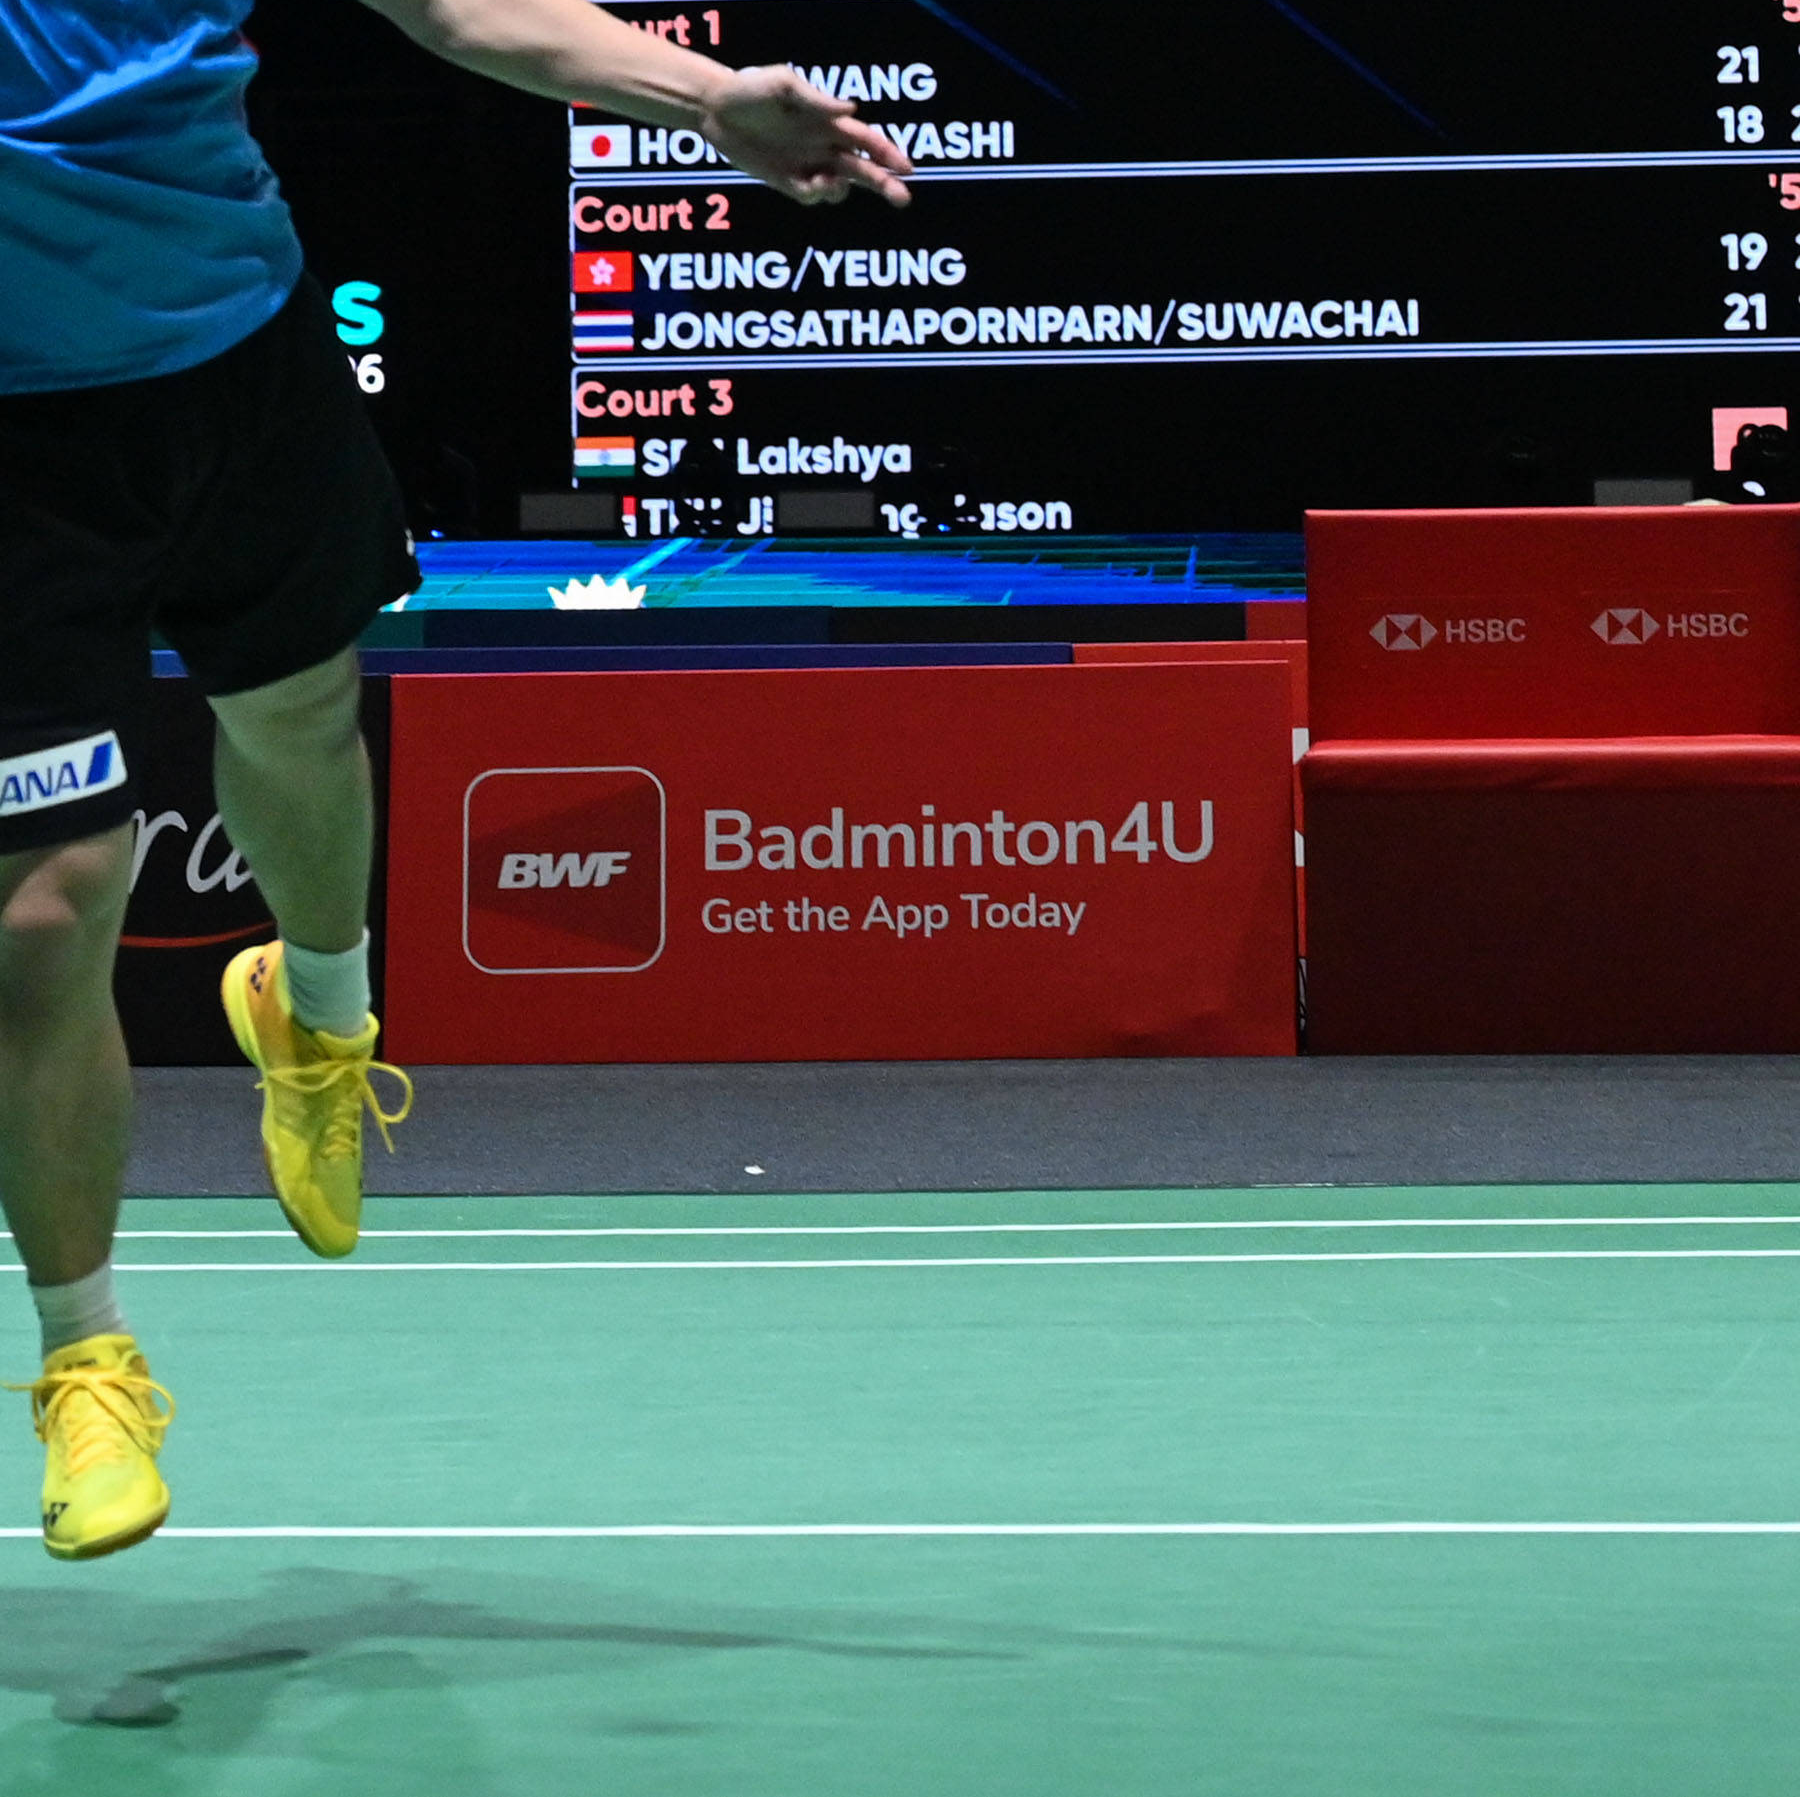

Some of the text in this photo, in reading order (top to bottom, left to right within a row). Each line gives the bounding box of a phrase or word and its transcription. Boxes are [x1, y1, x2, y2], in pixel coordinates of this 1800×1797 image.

[703, 9, 719, 45] 1
[788, 61, 937, 102] WANG
[1717, 45, 1760, 84] 21
[1717, 105, 1764, 143] 18
[574, 194, 731, 232] Court 2
[639, 246, 967, 292] YEUNG/YEUNG
[1720, 232, 1768, 270] 19
[642, 299, 1420, 351] JONGSATHAPORNPARN/SUWACHAI
[1724, 293, 1767, 331] 21
[575, 379, 734, 419] Court 3
[737, 436, 912, 482] Lakshya
[737, 495, 774, 535] Ji
[1445, 618, 1526, 644] HSBC
[1666, 613, 1749, 639] HSBC
[704, 799, 1215, 872] Badminton4U
[497, 851, 632, 890] BWF
[701, 892, 1087, 939] Get the App Today
